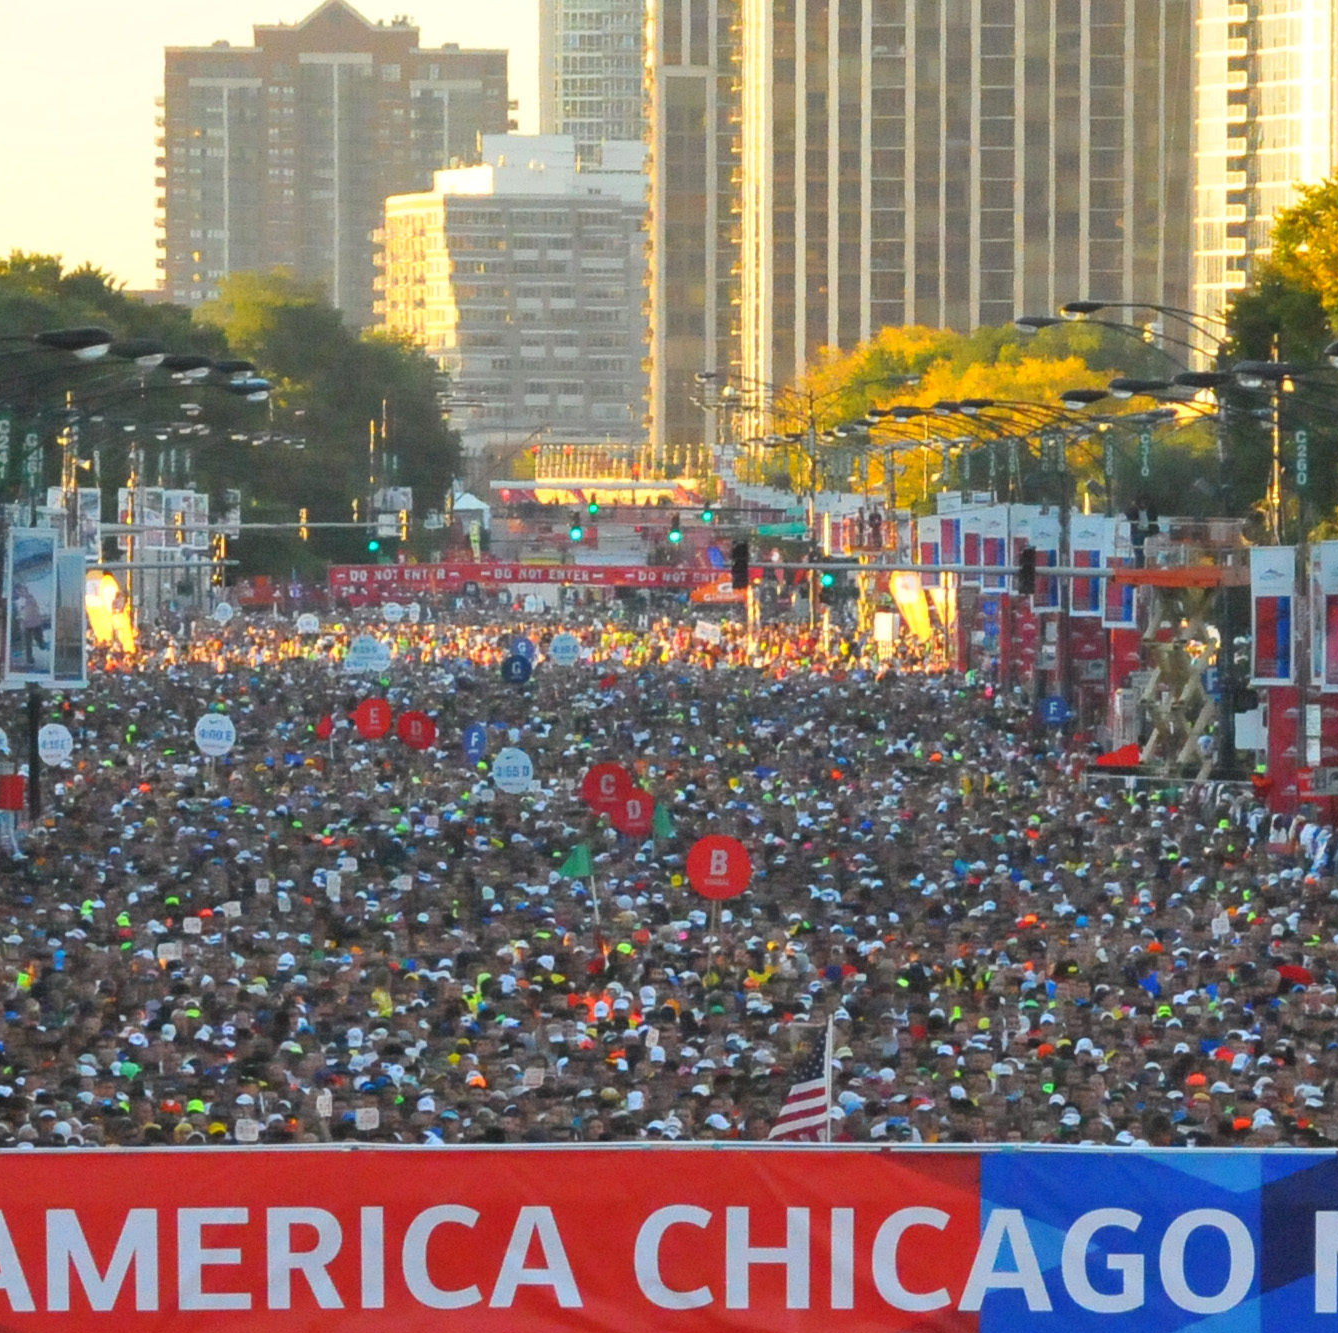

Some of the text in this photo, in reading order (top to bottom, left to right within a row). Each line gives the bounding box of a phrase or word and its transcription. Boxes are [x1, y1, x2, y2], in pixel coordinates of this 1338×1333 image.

[1294, 430, 1308, 485] C260
[349, 569, 368, 582] DO
[403, 569, 446, 582] ENTR
[517, 569, 544, 582] NOT
[547, 569, 590, 583] ENTER
[370, 706, 380, 726] E
[1049, 702, 1059, 714] F
[471, 731, 479, 747] F
[600, 773, 616, 796] C
[626, 799, 642, 819] D
[709, 849, 729, 876] B
[633, 1204, 1255, 1318] CHICAGO
